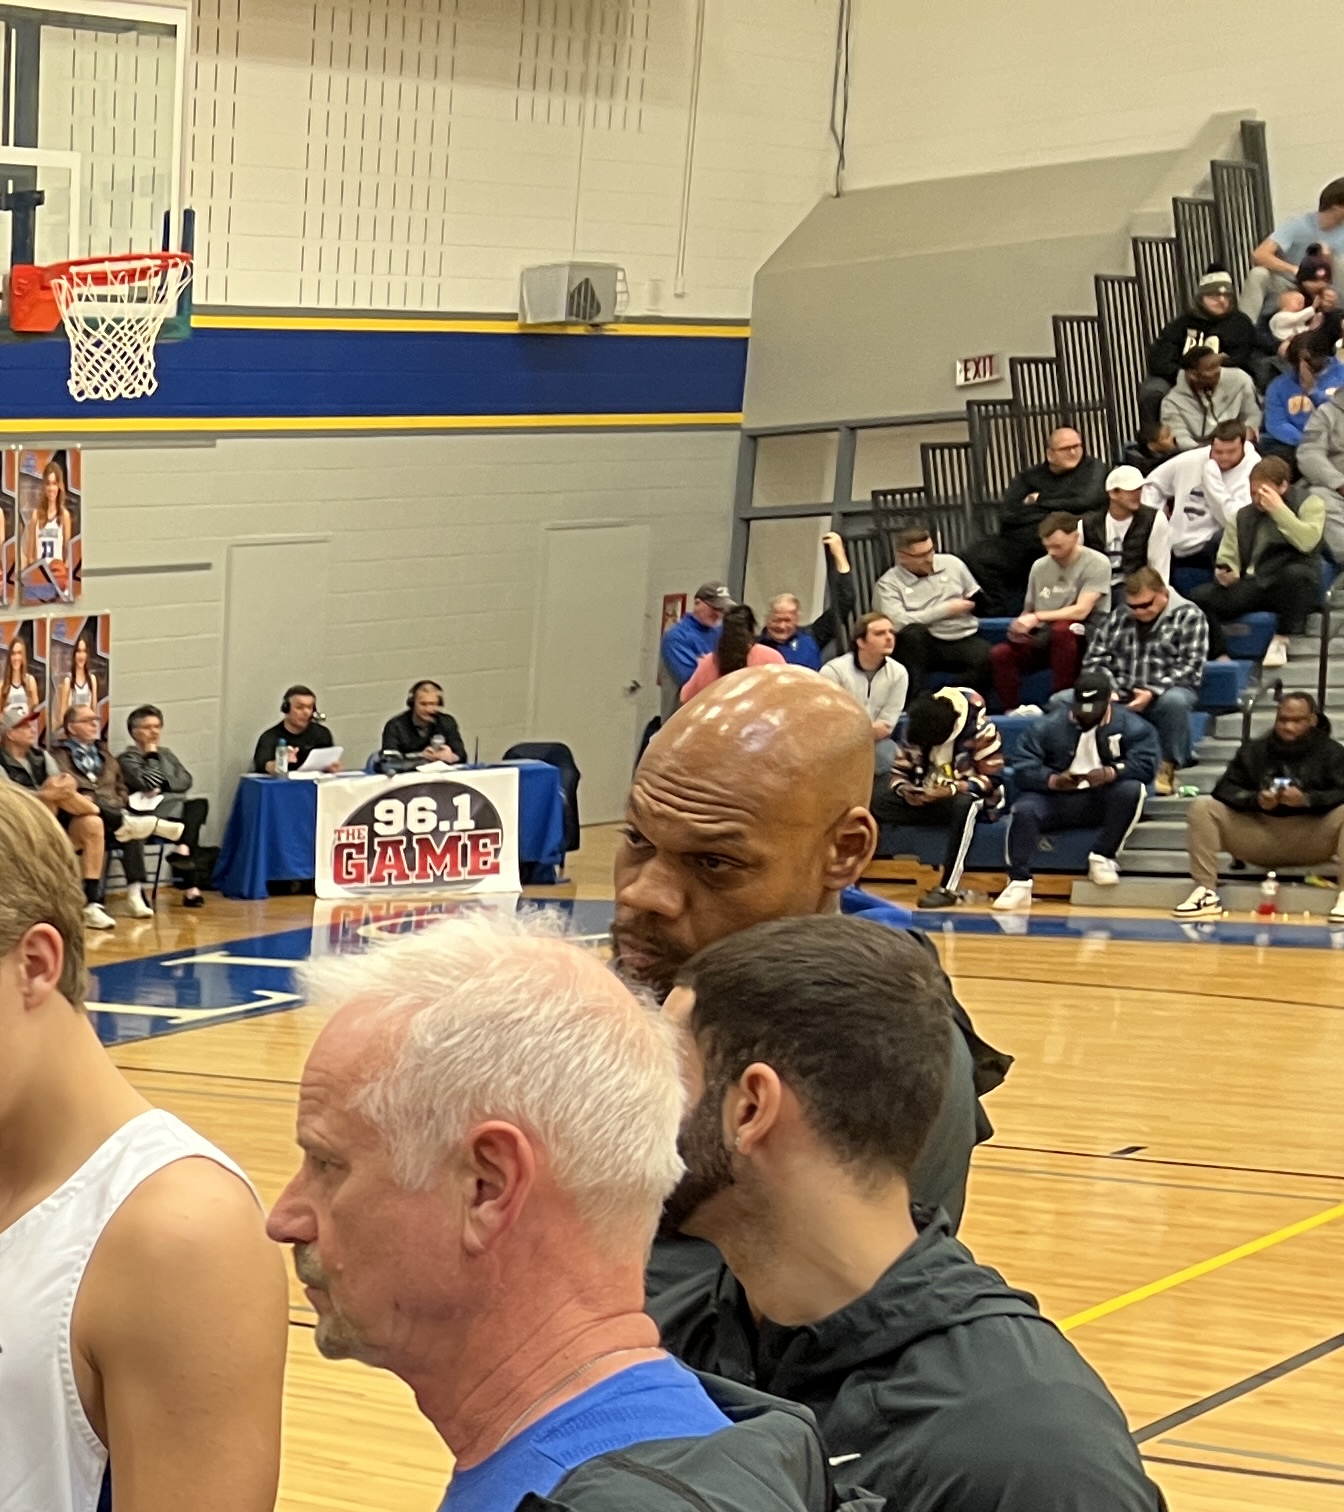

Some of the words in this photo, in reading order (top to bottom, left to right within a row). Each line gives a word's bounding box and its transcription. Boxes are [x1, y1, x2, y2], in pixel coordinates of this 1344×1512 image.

[963, 354, 995, 382] EXIT
[373, 793, 475, 836] 96.1
[334, 828, 366, 842] THE
[332, 829, 502, 886] GAME
